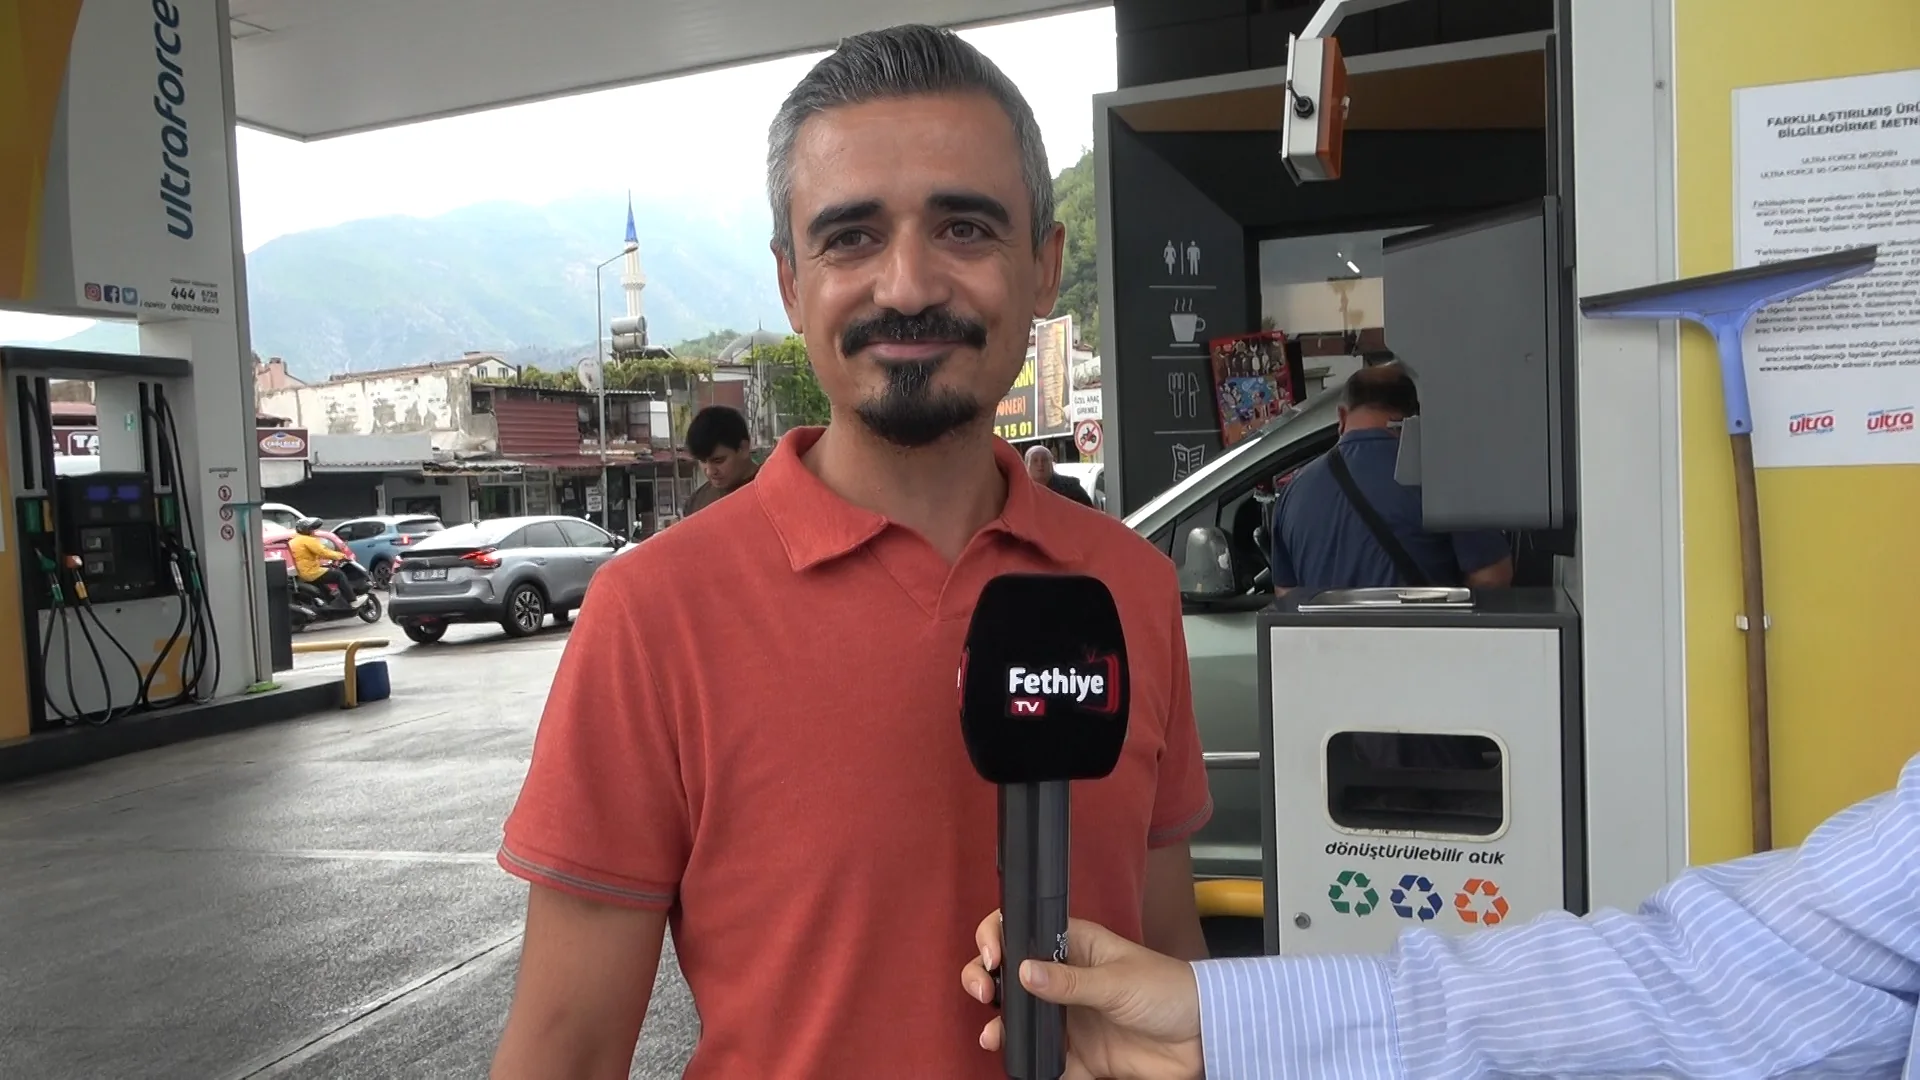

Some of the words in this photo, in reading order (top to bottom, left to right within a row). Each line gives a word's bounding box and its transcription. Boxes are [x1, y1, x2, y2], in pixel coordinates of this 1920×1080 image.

[153, 0, 193, 240] ultraforce
[1778, 119, 1877, 139] BİLGİLENDİRME
[171, 285, 196, 301] 444
[1004, 423, 1017, 438] 15
[1019, 421, 1032, 436] 01
[1789, 413, 1834, 433] ultra
[1867, 410, 1914, 431] ultra
[1009, 667, 1104, 703] Fethiye
[1014, 700, 1040, 712] TV
[1325, 841, 1464, 863] dönüştürülebilir
[1468, 849, 1504, 865] atık
